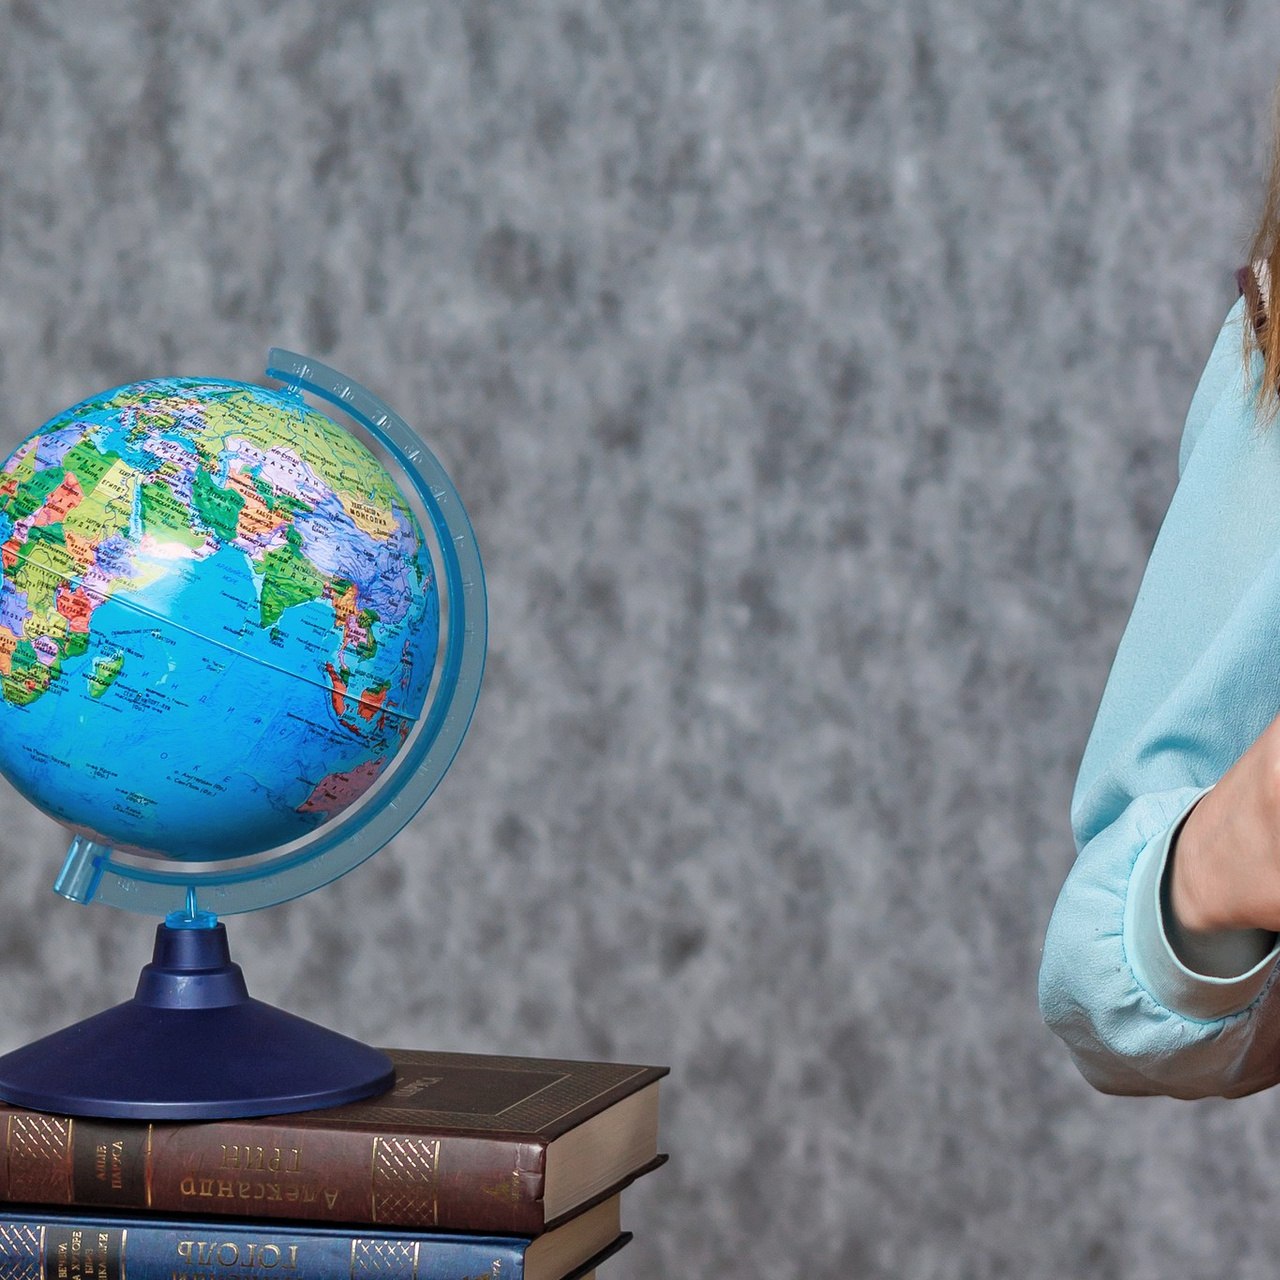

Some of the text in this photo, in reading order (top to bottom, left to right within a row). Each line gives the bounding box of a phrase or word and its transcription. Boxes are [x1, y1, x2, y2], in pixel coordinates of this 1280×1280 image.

[245, 447, 319, 488] КАЗАХСТАН
[101, 478, 125, 494] ЕГИПЕТ
[349, 508, 387, 526] МОНГОЛИЯ
[268, 561, 317, 587] ИНДИЯ
[111, 1140, 124, 1189] ПАРУСА
[220, 1144, 302, 1174] ГРИН
[180, 1170, 339, 1210] Александр
[177, 1240, 299, 1270] ГОГОЛЬ
